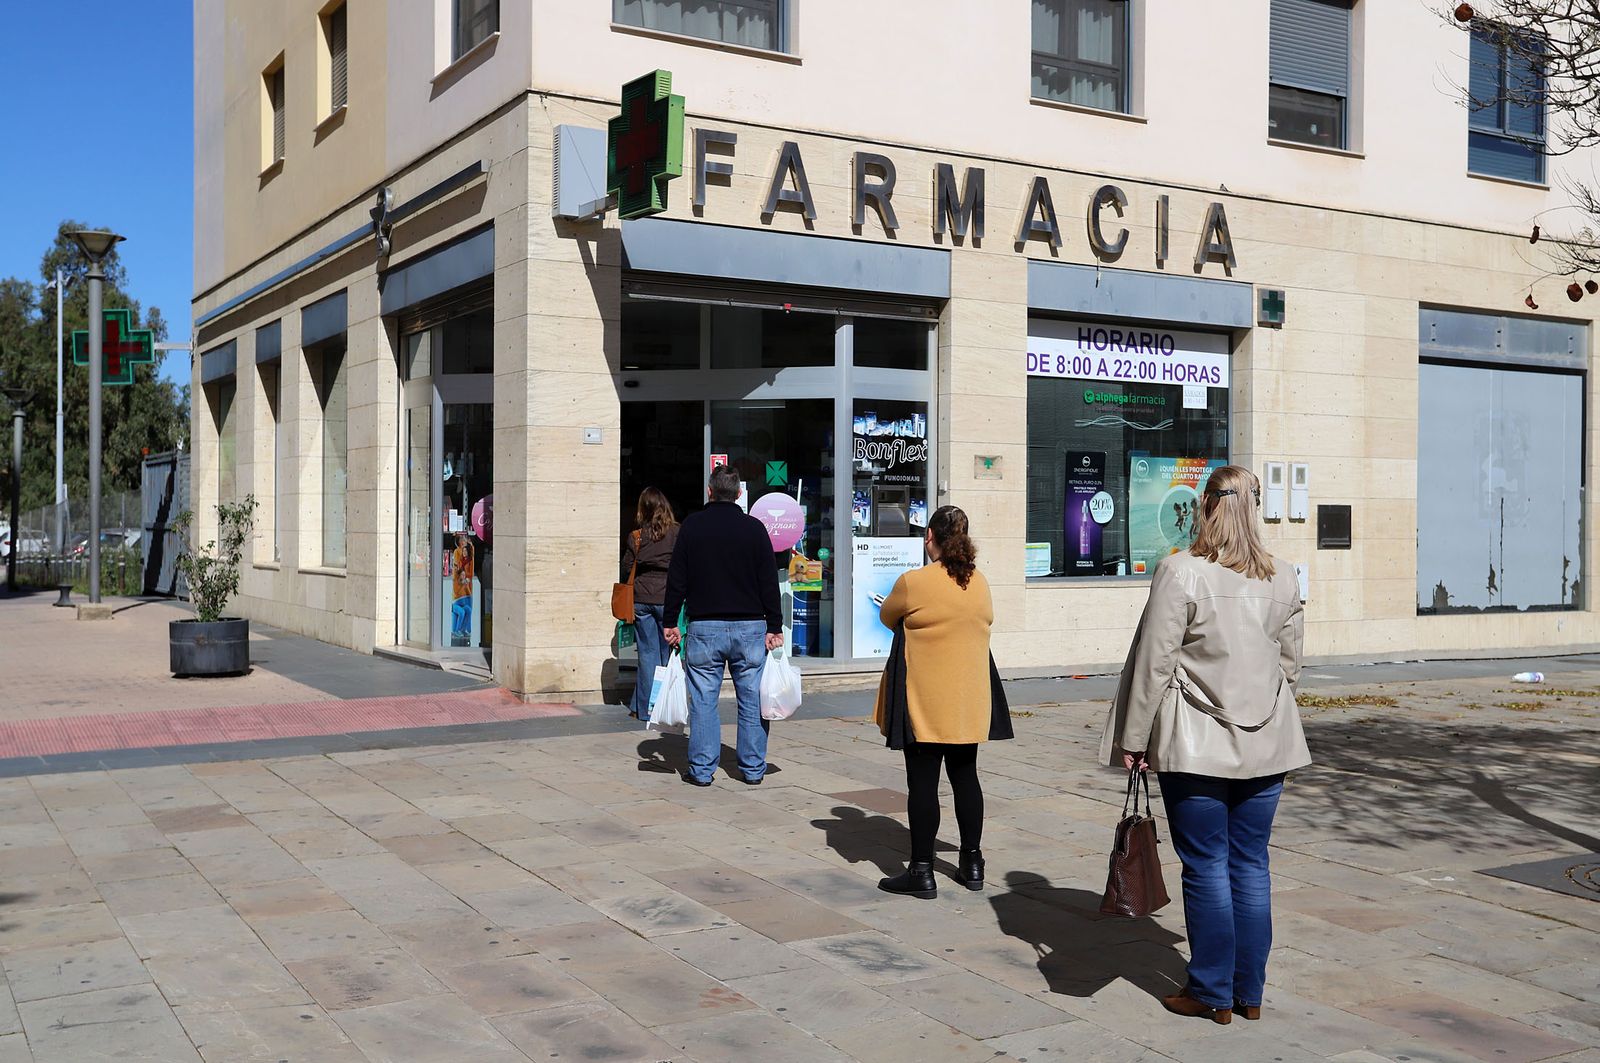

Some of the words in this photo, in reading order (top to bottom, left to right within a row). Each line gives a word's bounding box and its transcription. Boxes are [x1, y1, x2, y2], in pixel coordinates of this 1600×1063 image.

[692, 128, 1237, 270] FARMACIA
[1077, 327, 1175, 357] HORARIO
[1027, 352, 1050, 372] DE
[1056, 355, 1092, 376] 8:00
[1096, 358, 1109, 377] A
[1113, 359, 1157, 380] 22:00
[1162, 362, 1221, 384] HORAS
[853, 437, 928, 469] Bonflex
[1180, 465, 1189, 473] LES
[1189, 466, 1213, 474] PROTEGE
[1092, 498, 1112, 511] 20%
